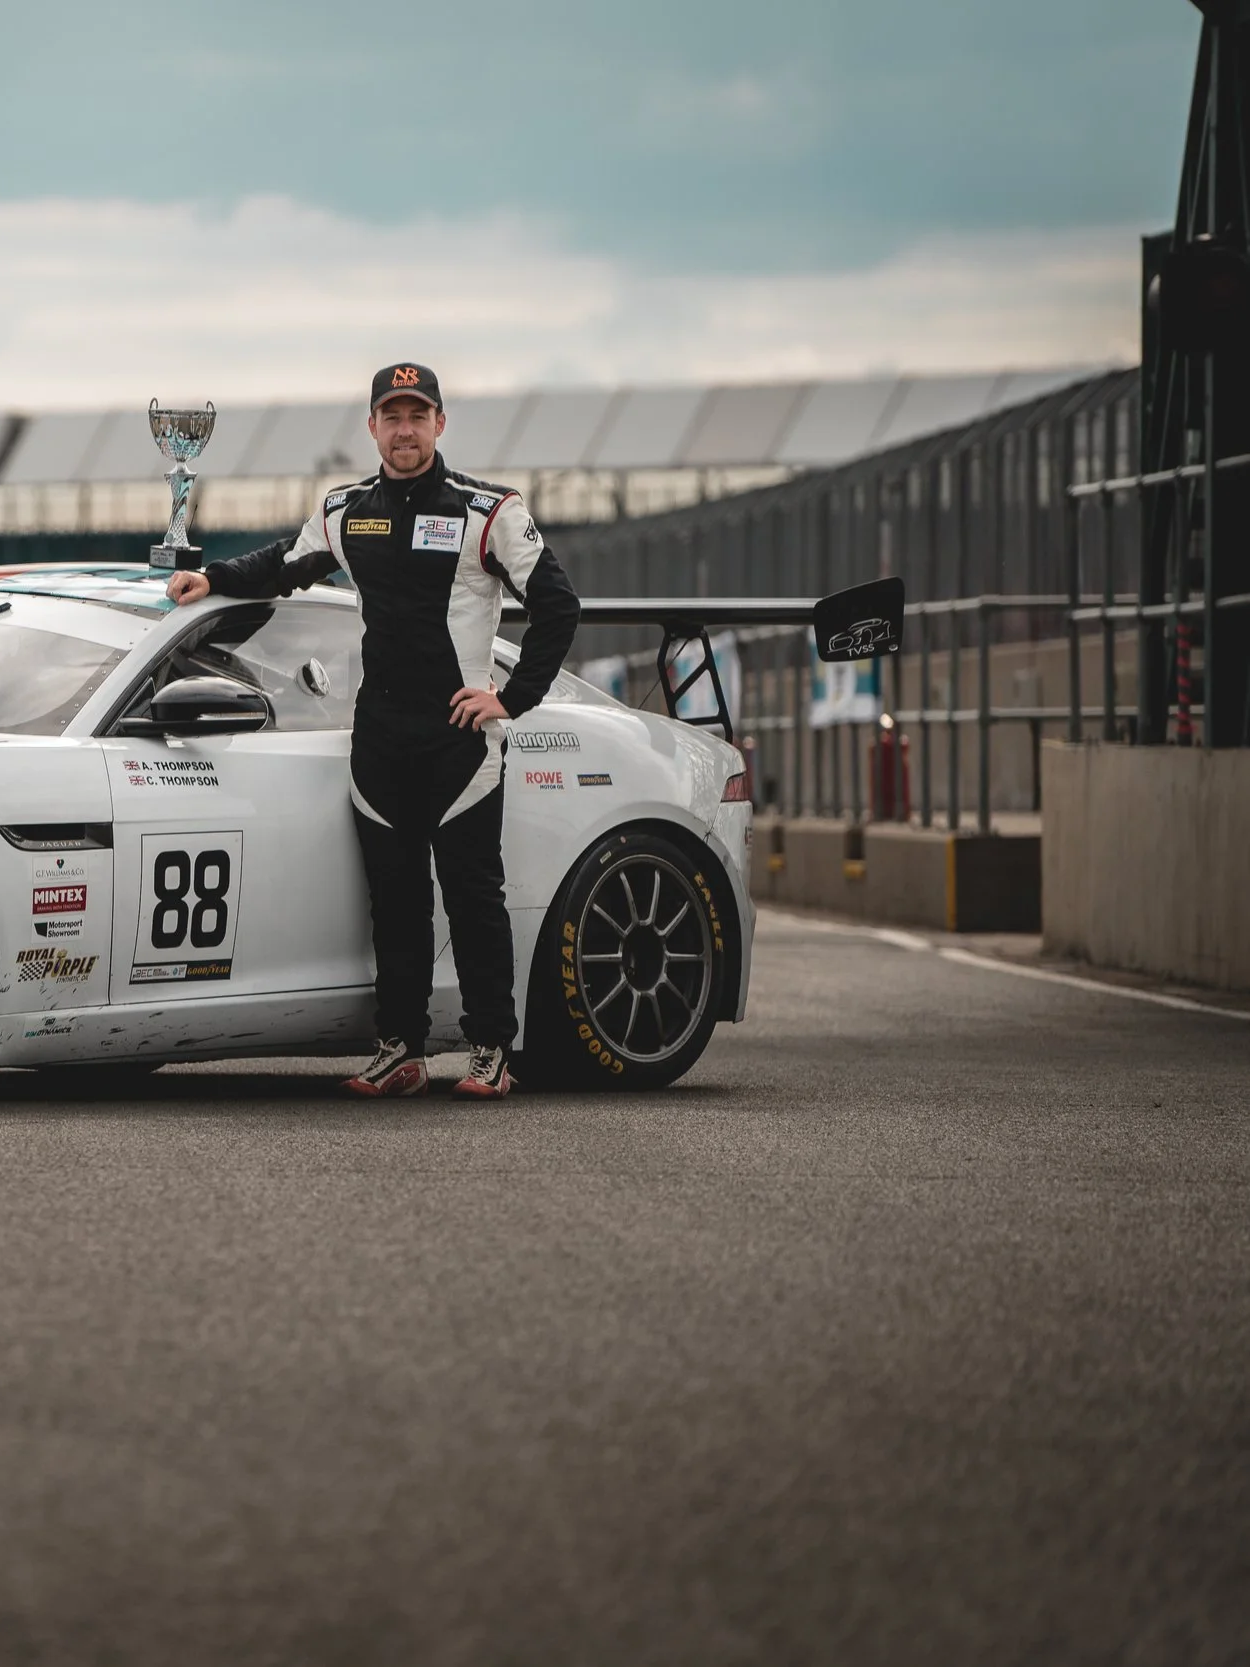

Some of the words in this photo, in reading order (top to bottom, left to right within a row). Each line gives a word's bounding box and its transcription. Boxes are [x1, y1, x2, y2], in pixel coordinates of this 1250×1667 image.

[326, 493, 347, 507] OMP
[471, 495, 494, 509] OMP
[350, 522, 388, 531] GOODYEAR
[847, 644, 875, 657] TVSS
[506, 727, 580, 752] Longman
[142, 762, 153, 771] A.
[154, 761, 215, 771] THOMPSON
[146, 776, 158, 785] C.
[159, 776, 219, 786] THOMPSON
[525, 772, 563, 784] ROWE
[34, 888, 83, 904] MINTEX
[151, 850, 230, 949] 88
[694, 871, 723, 952] EAGLE
[49, 919, 83, 929] Motorsport
[48, 930, 80, 938] Showroom
[16, 948, 55, 963] ROYAL
[42, 956, 96, 979] PURPLE
[187, 964, 230, 976] GOODYEAR
[562, 921, 623, 1074] GOODYEAR
